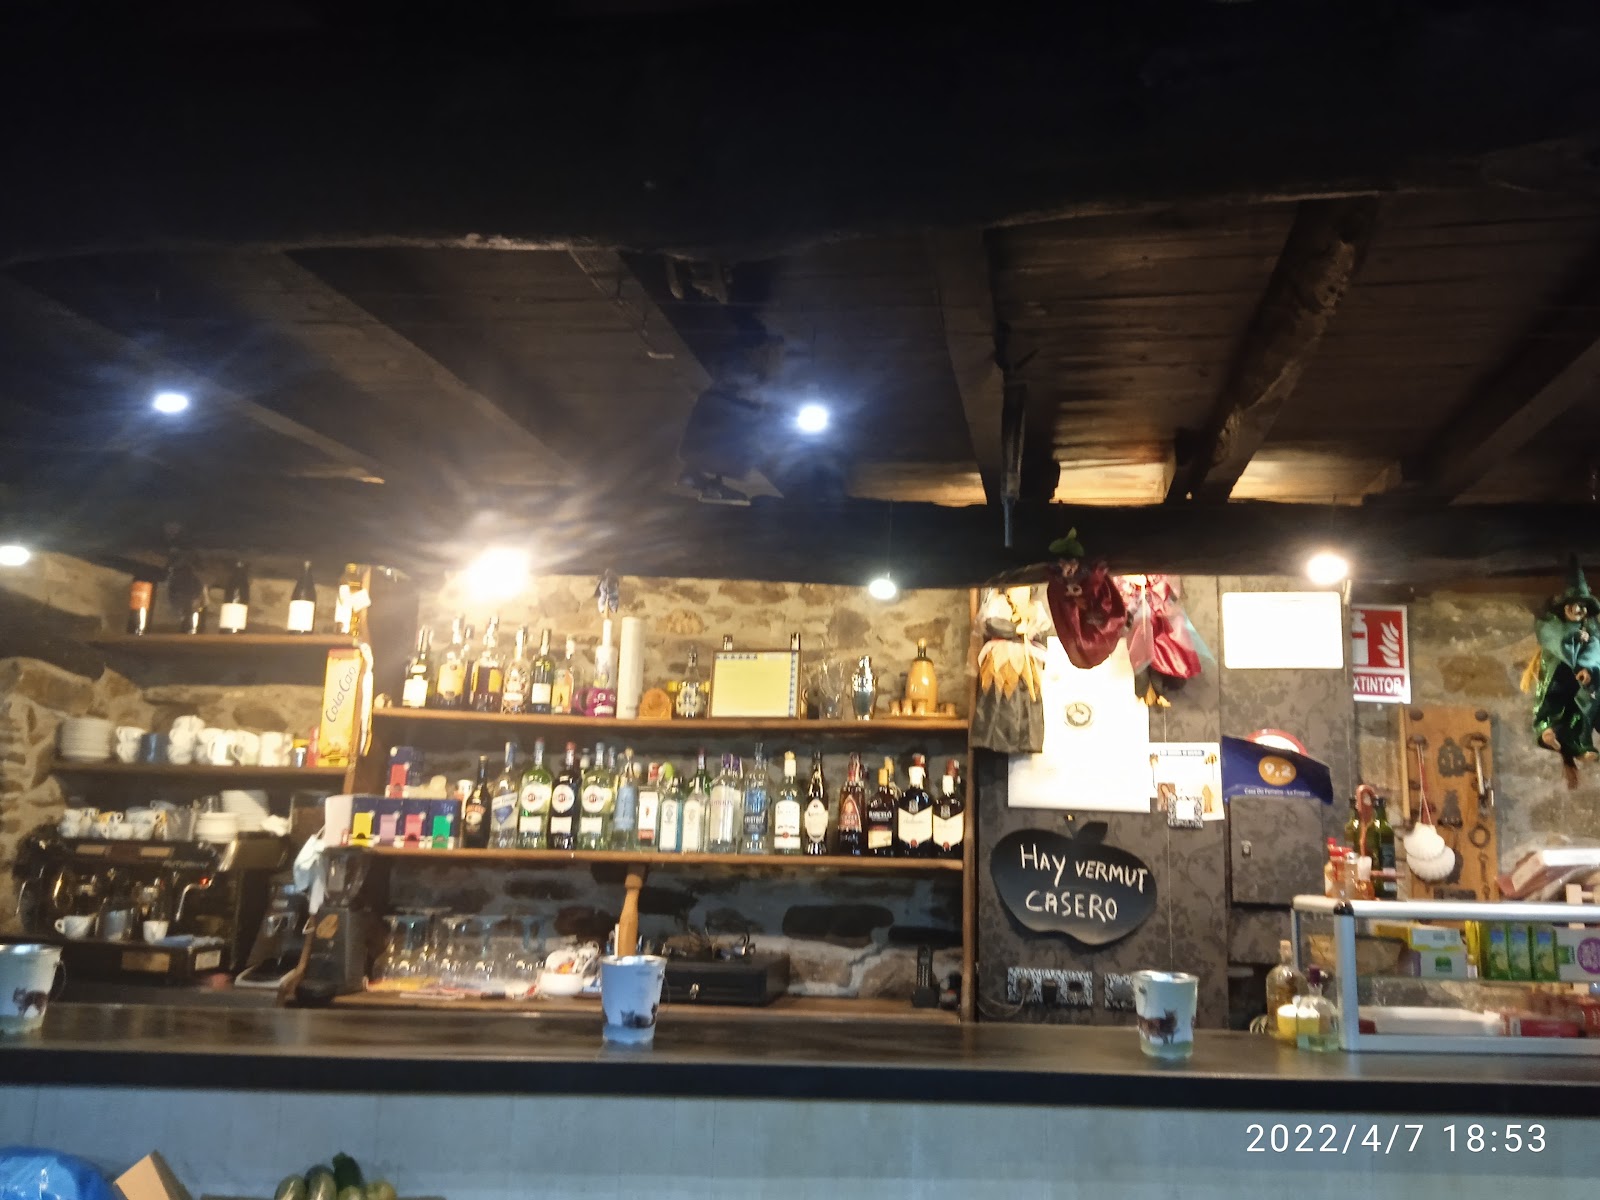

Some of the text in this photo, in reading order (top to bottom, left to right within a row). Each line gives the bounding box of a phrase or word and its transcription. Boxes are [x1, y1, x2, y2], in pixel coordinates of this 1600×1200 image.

[1353, 676, 1402, 694] XTINTOR
[1020, 843, 1148, 894] HAY VERMUT
[1025, 890, 1118, 923] CASERO
